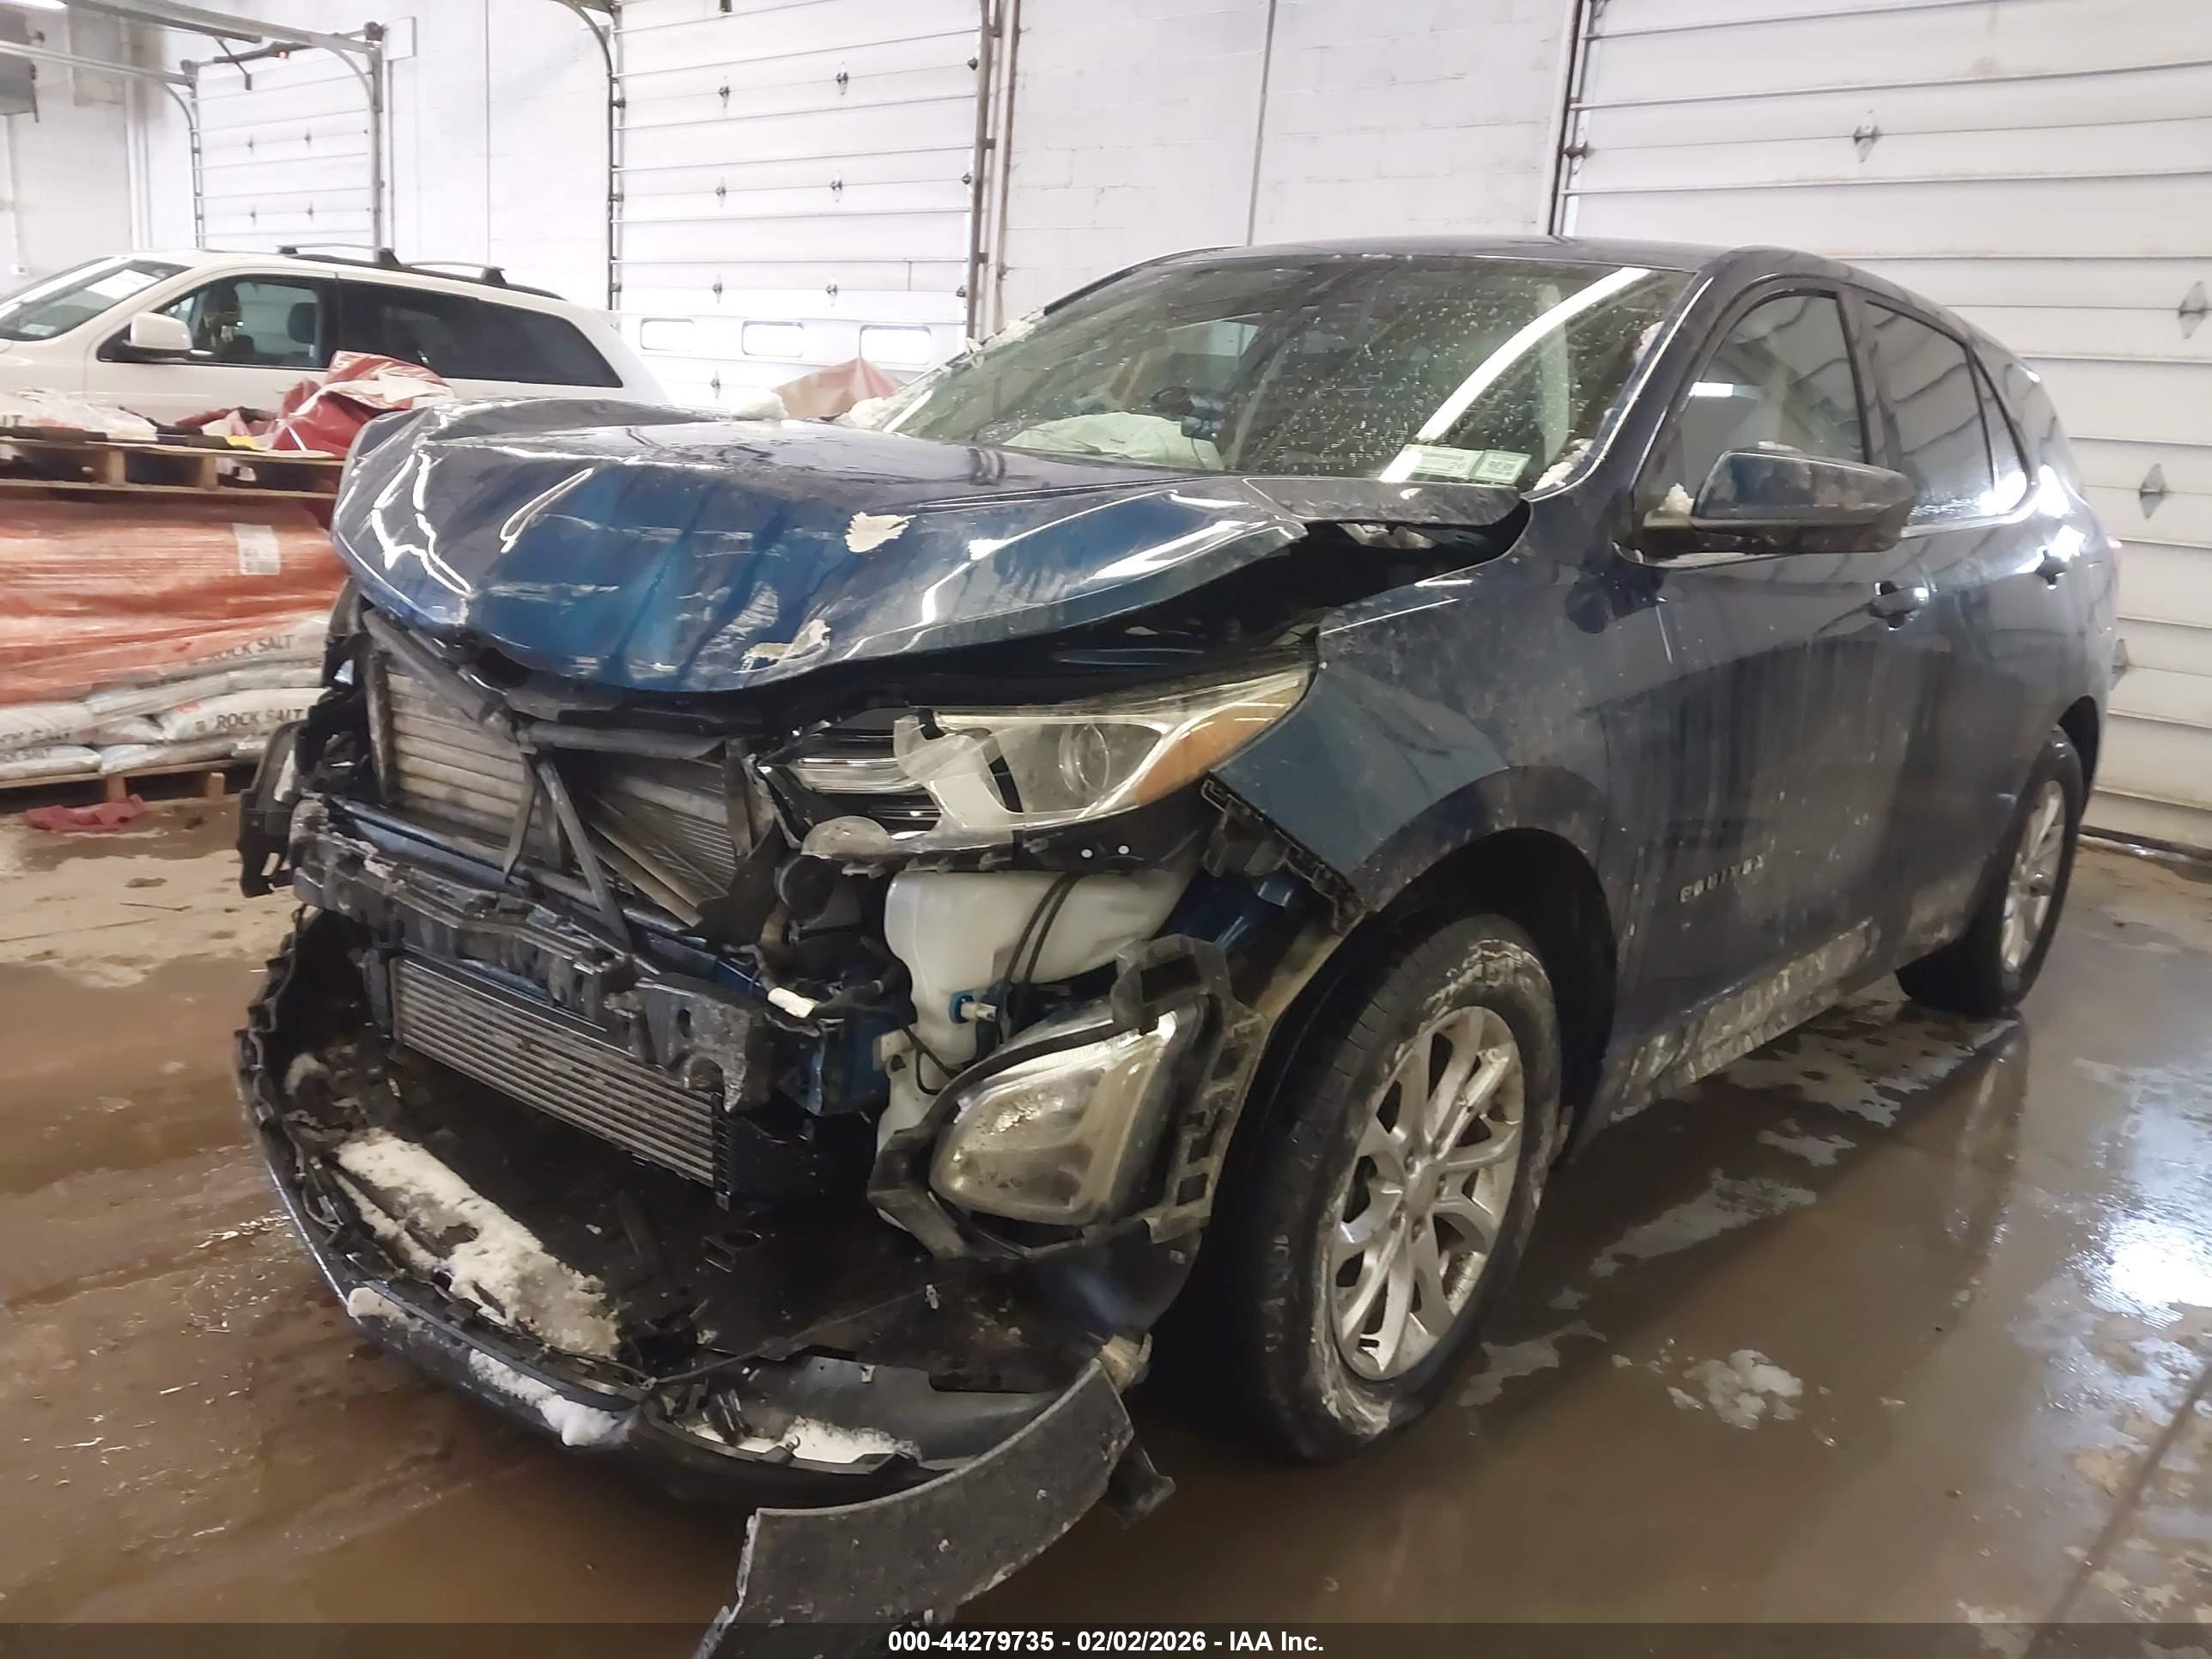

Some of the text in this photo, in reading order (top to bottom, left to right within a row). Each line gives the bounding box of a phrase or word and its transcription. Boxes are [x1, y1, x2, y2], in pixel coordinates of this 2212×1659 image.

[257, 633, 295, 653] SALT
[216, 711, 259, 730] ROCK
[265, 708, 304, 722] SALT
